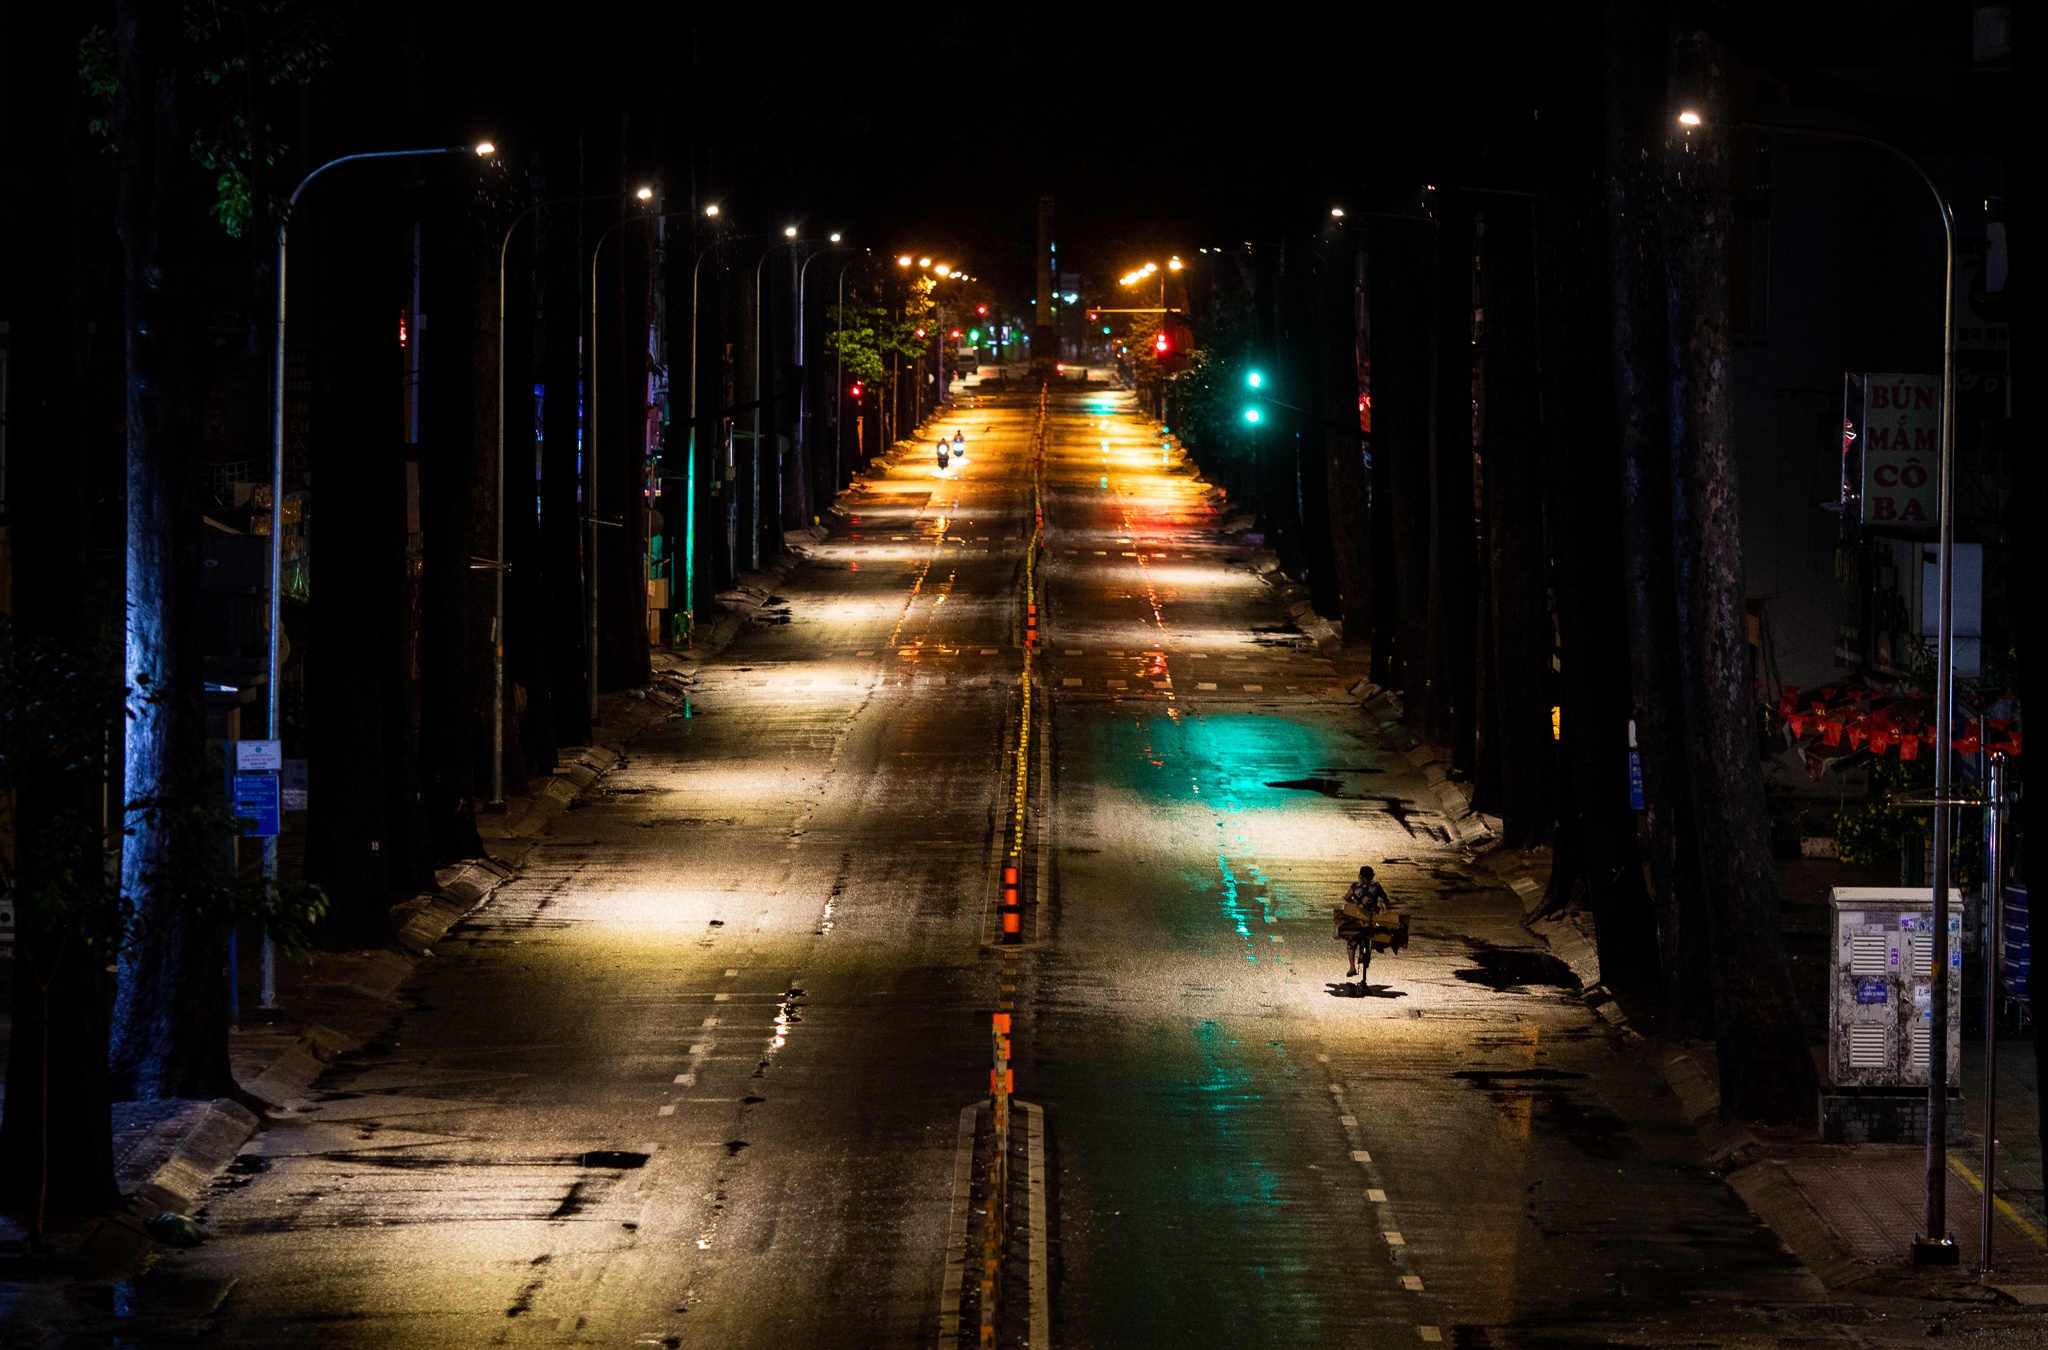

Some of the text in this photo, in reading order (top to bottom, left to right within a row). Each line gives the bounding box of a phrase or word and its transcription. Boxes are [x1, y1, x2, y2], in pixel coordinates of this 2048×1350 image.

[1870, 378, 1934, 410] BÚN
[1867, 414, 1937, 451] MẮM
[1873, 457, 1927, 489] CÔ
[1872, 497, 1928, 521] BA
